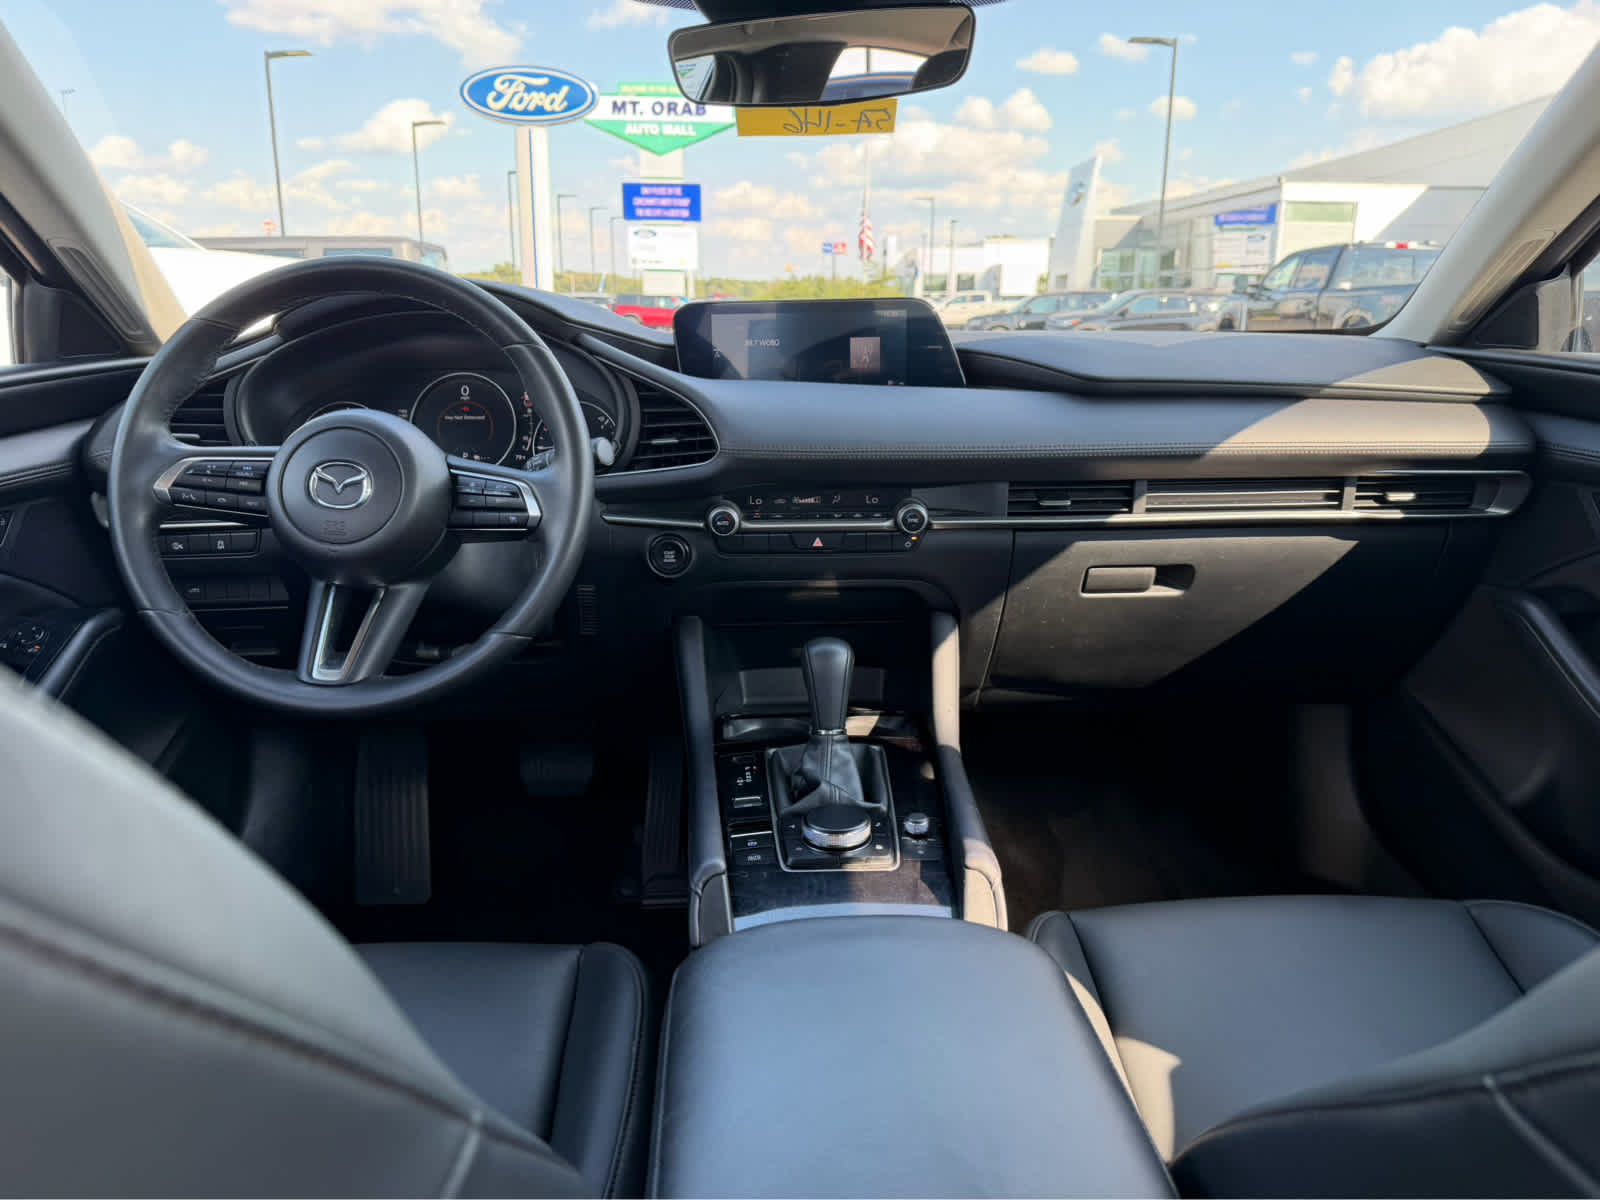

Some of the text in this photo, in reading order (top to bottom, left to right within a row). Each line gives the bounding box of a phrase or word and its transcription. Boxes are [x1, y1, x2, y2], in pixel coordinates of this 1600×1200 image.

[486, 74, 569, 112] Ford
[612, 100, 707, 116] MT. ORAB
[625, 123, 697, 137] AUTO MALL
[460, 384, 470, 397] 0
